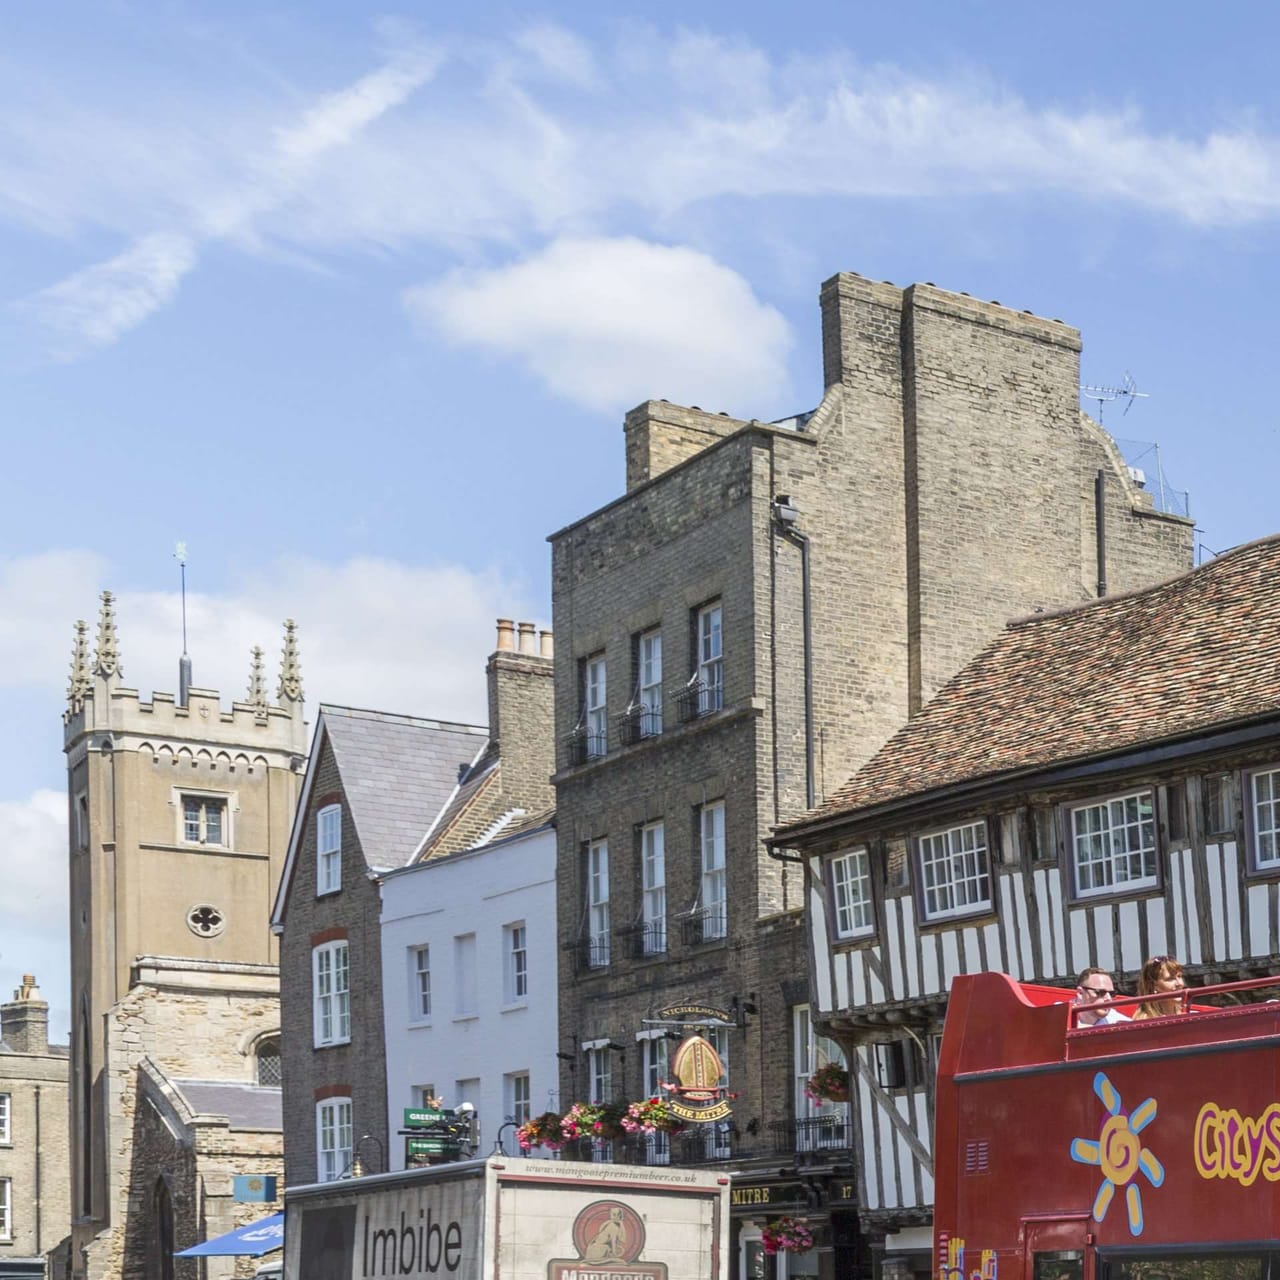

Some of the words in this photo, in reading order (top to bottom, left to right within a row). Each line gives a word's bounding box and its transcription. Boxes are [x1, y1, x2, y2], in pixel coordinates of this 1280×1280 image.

[409, 1113, 441, 1121] GREENE
[672, 1104, 694, 1119] THE
[695, 1103, 730, 1119] MITRE
[525, 1164, 697, 1184] www.mongoosepremiumbeer.co.uk
[732, 1187, 770, 1205] MITRE
[841, 1185, 852, 1199] 17
[363, 1208, 462, 1277] Imbibe
